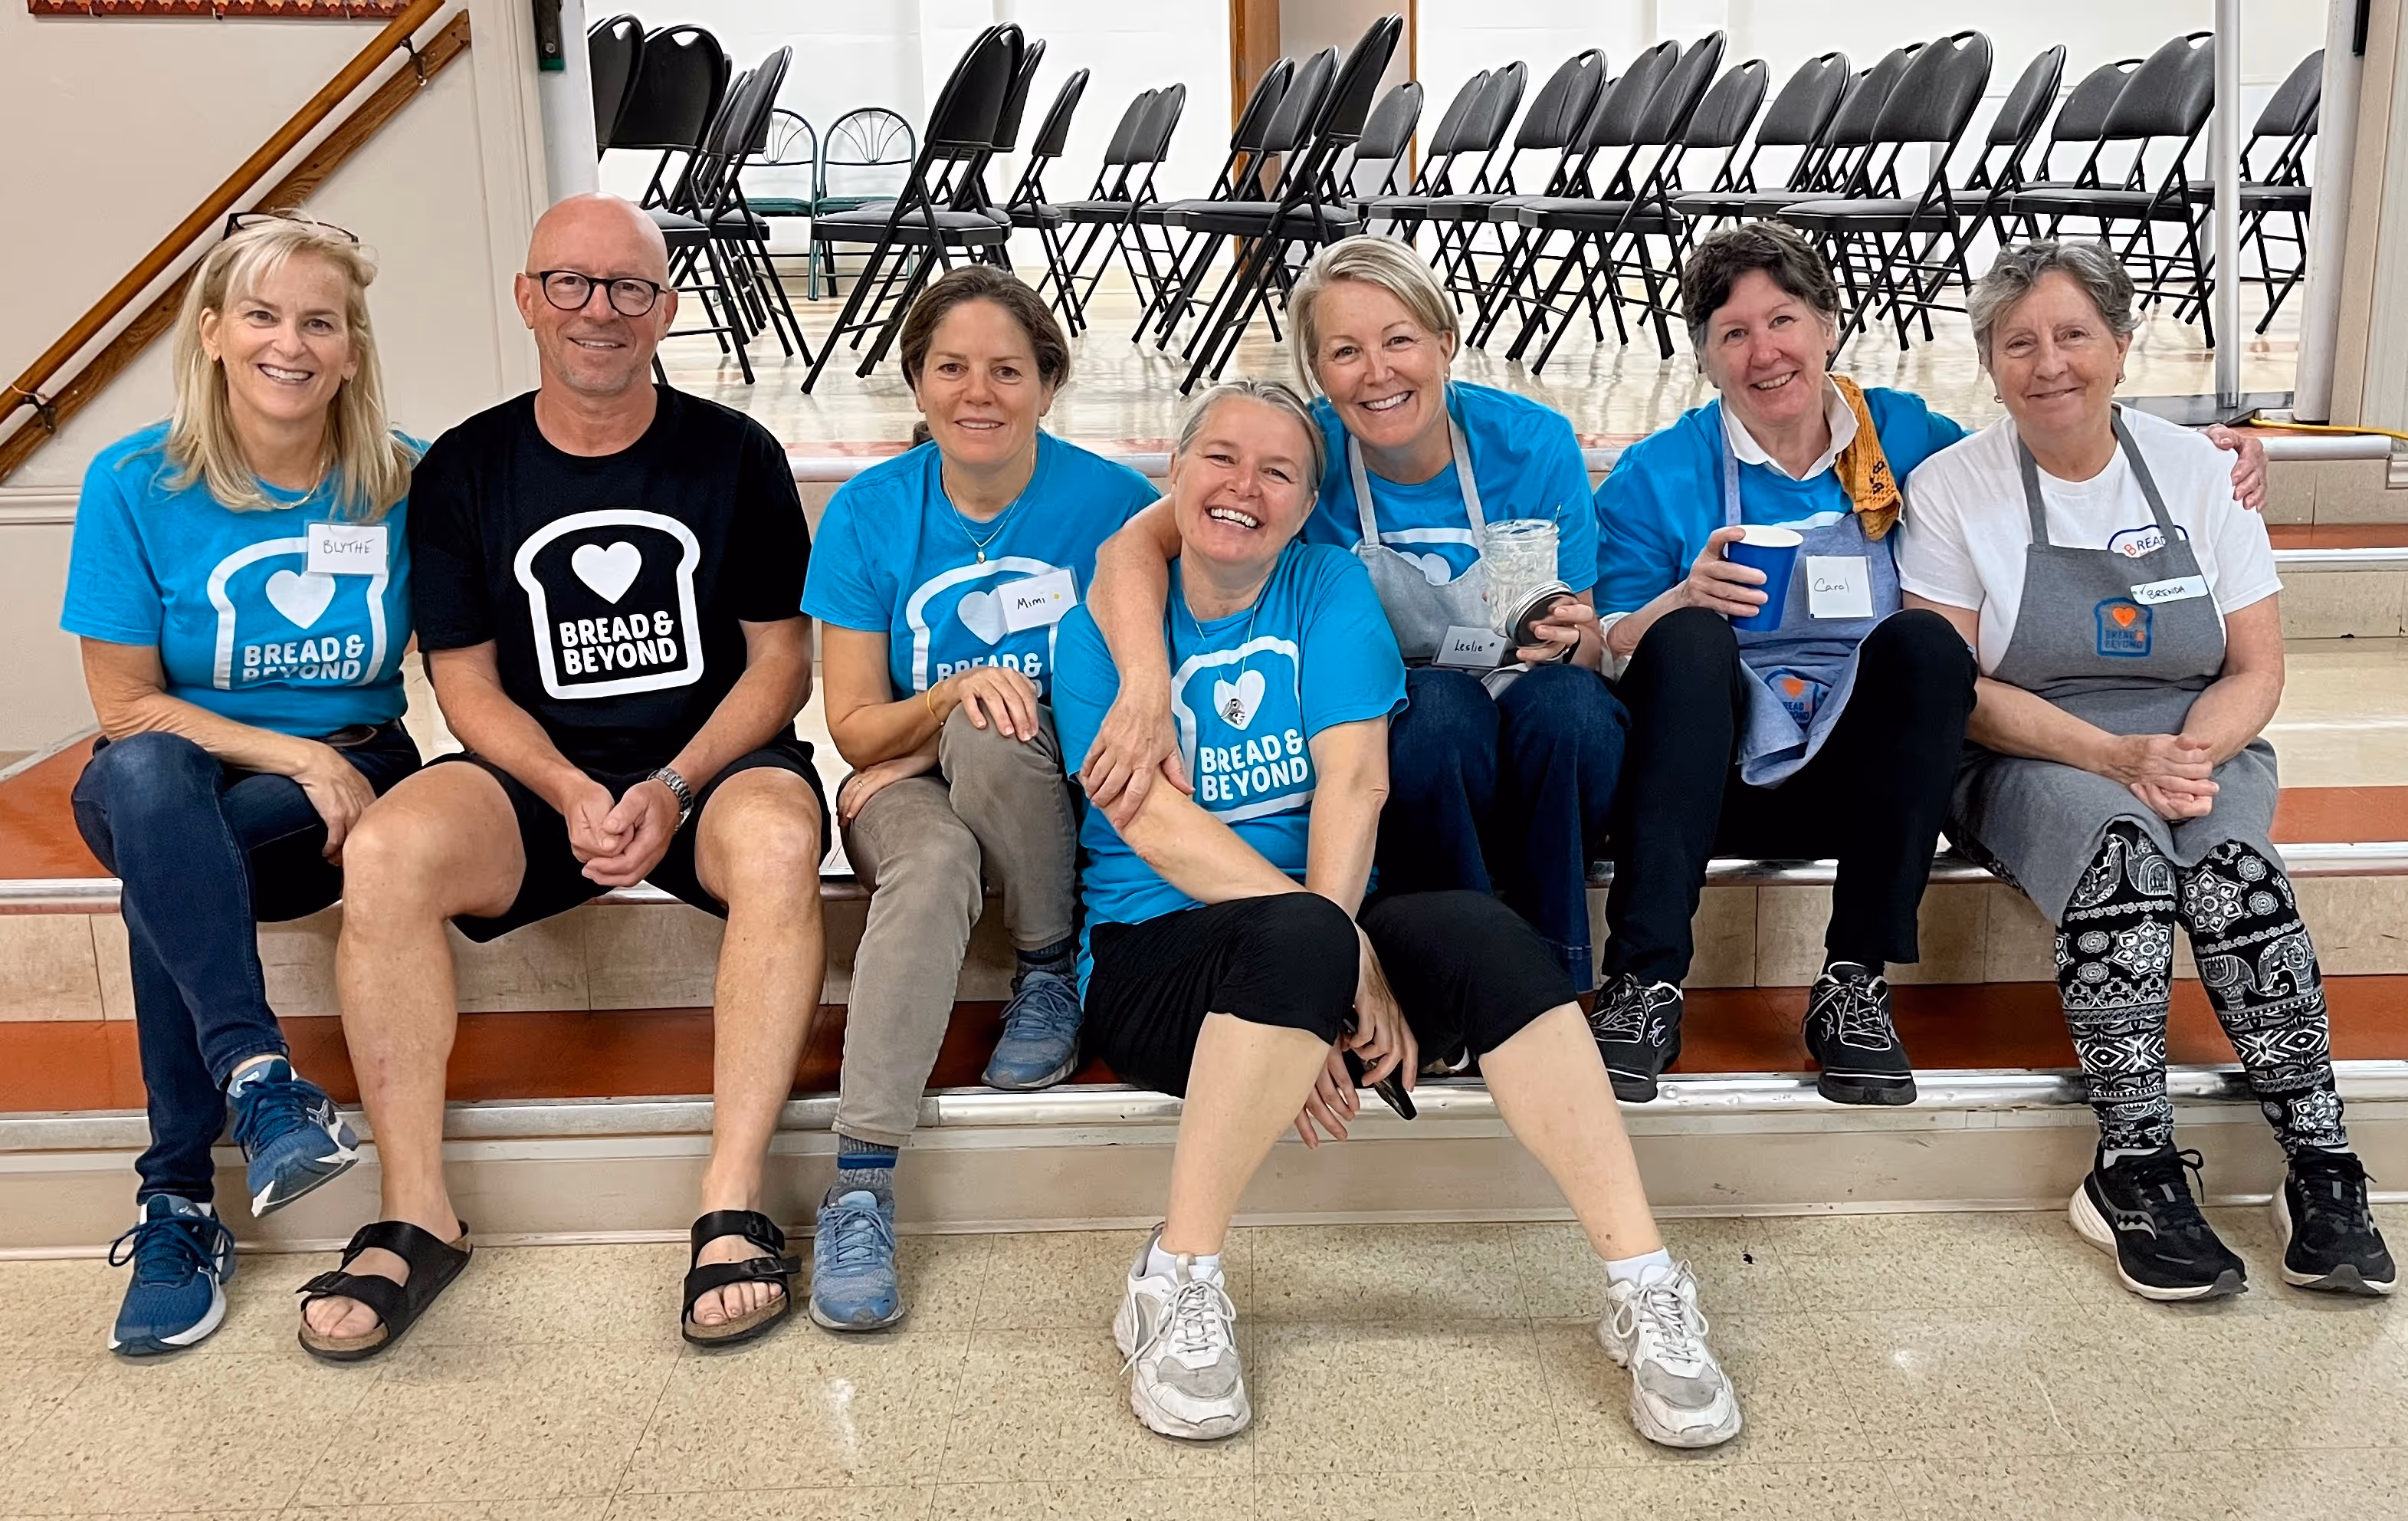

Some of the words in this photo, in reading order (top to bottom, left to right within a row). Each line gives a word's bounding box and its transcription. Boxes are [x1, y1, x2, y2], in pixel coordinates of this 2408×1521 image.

[323, 538, 375, 554] BLYTHE
[1813, 577, 1849, 593] Carol
[2146, 586, 2187, 600] BRENDA
[1017, 597, 1045, 610] Mimi
[559, 613, 650, 647] BREAD
[653, 610, 674, 636] &
[244, 636, 340, 666] BREAD
[345, 634, 366, 659] &
[563, 637, 677, 675] BEYOND
[1454, 639, 1483, 652] Leslie
[1023, 652, 1042, 678] &
[1199, 734, 1281, 773] BREAD
[1284, 728, 1303, 755] &
[1201, 756, 1308, 801] BEYOND
